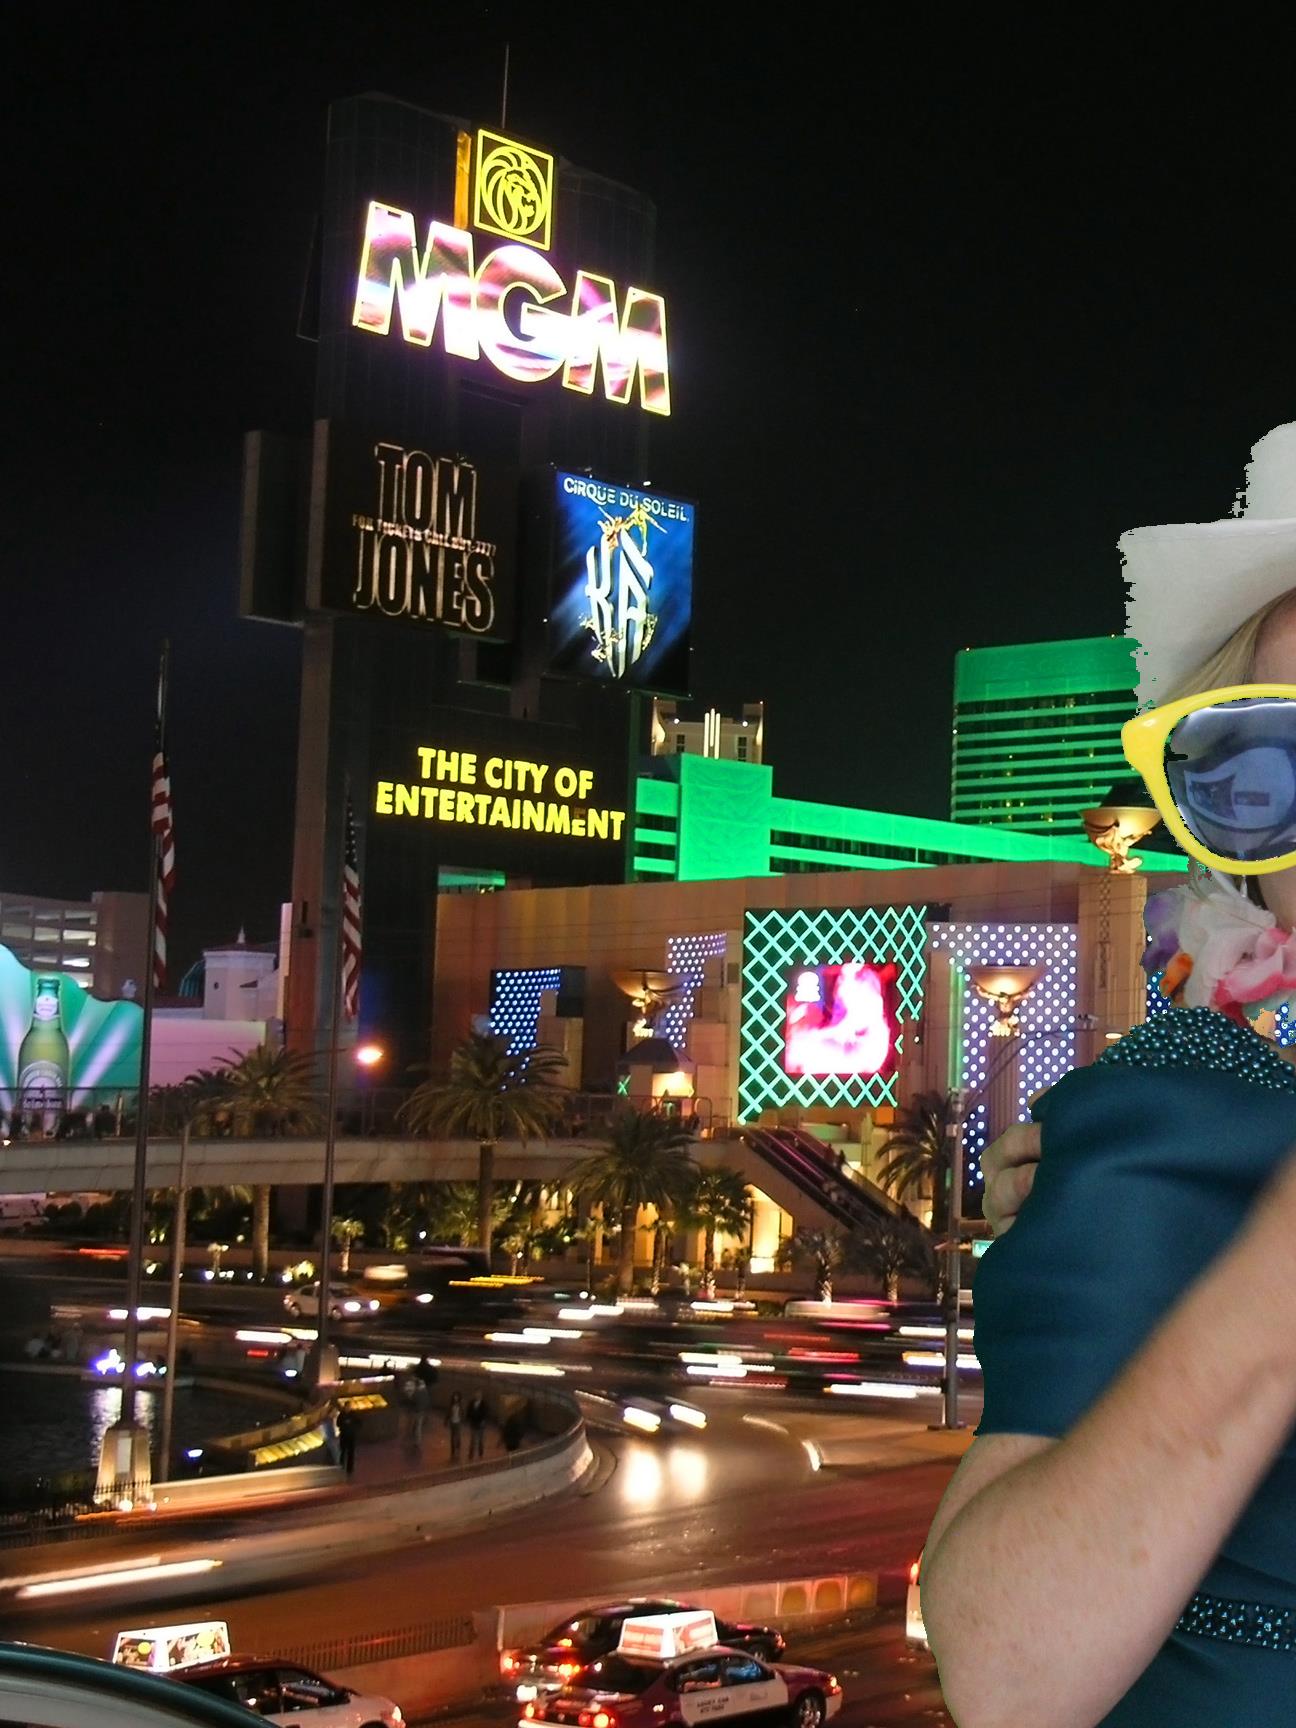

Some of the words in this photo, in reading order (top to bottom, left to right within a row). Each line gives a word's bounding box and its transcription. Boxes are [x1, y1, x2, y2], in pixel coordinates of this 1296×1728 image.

[353, 201, 671, 416] MGM
[374, 442, 477, 540] TOM
[563, 477, 616, 506] CIRQUE
[620, 492, 639, 509] DU
[642, 498, 688, 522] SOLEIL
[352, 529, 496, 633] JONES
[375, 781, 626, 841] ENTERTAINMENT
[417, 746, 477, 785] THE
[484, 757, 549, 794] CITY
[554, 767, 594, 799] OF
